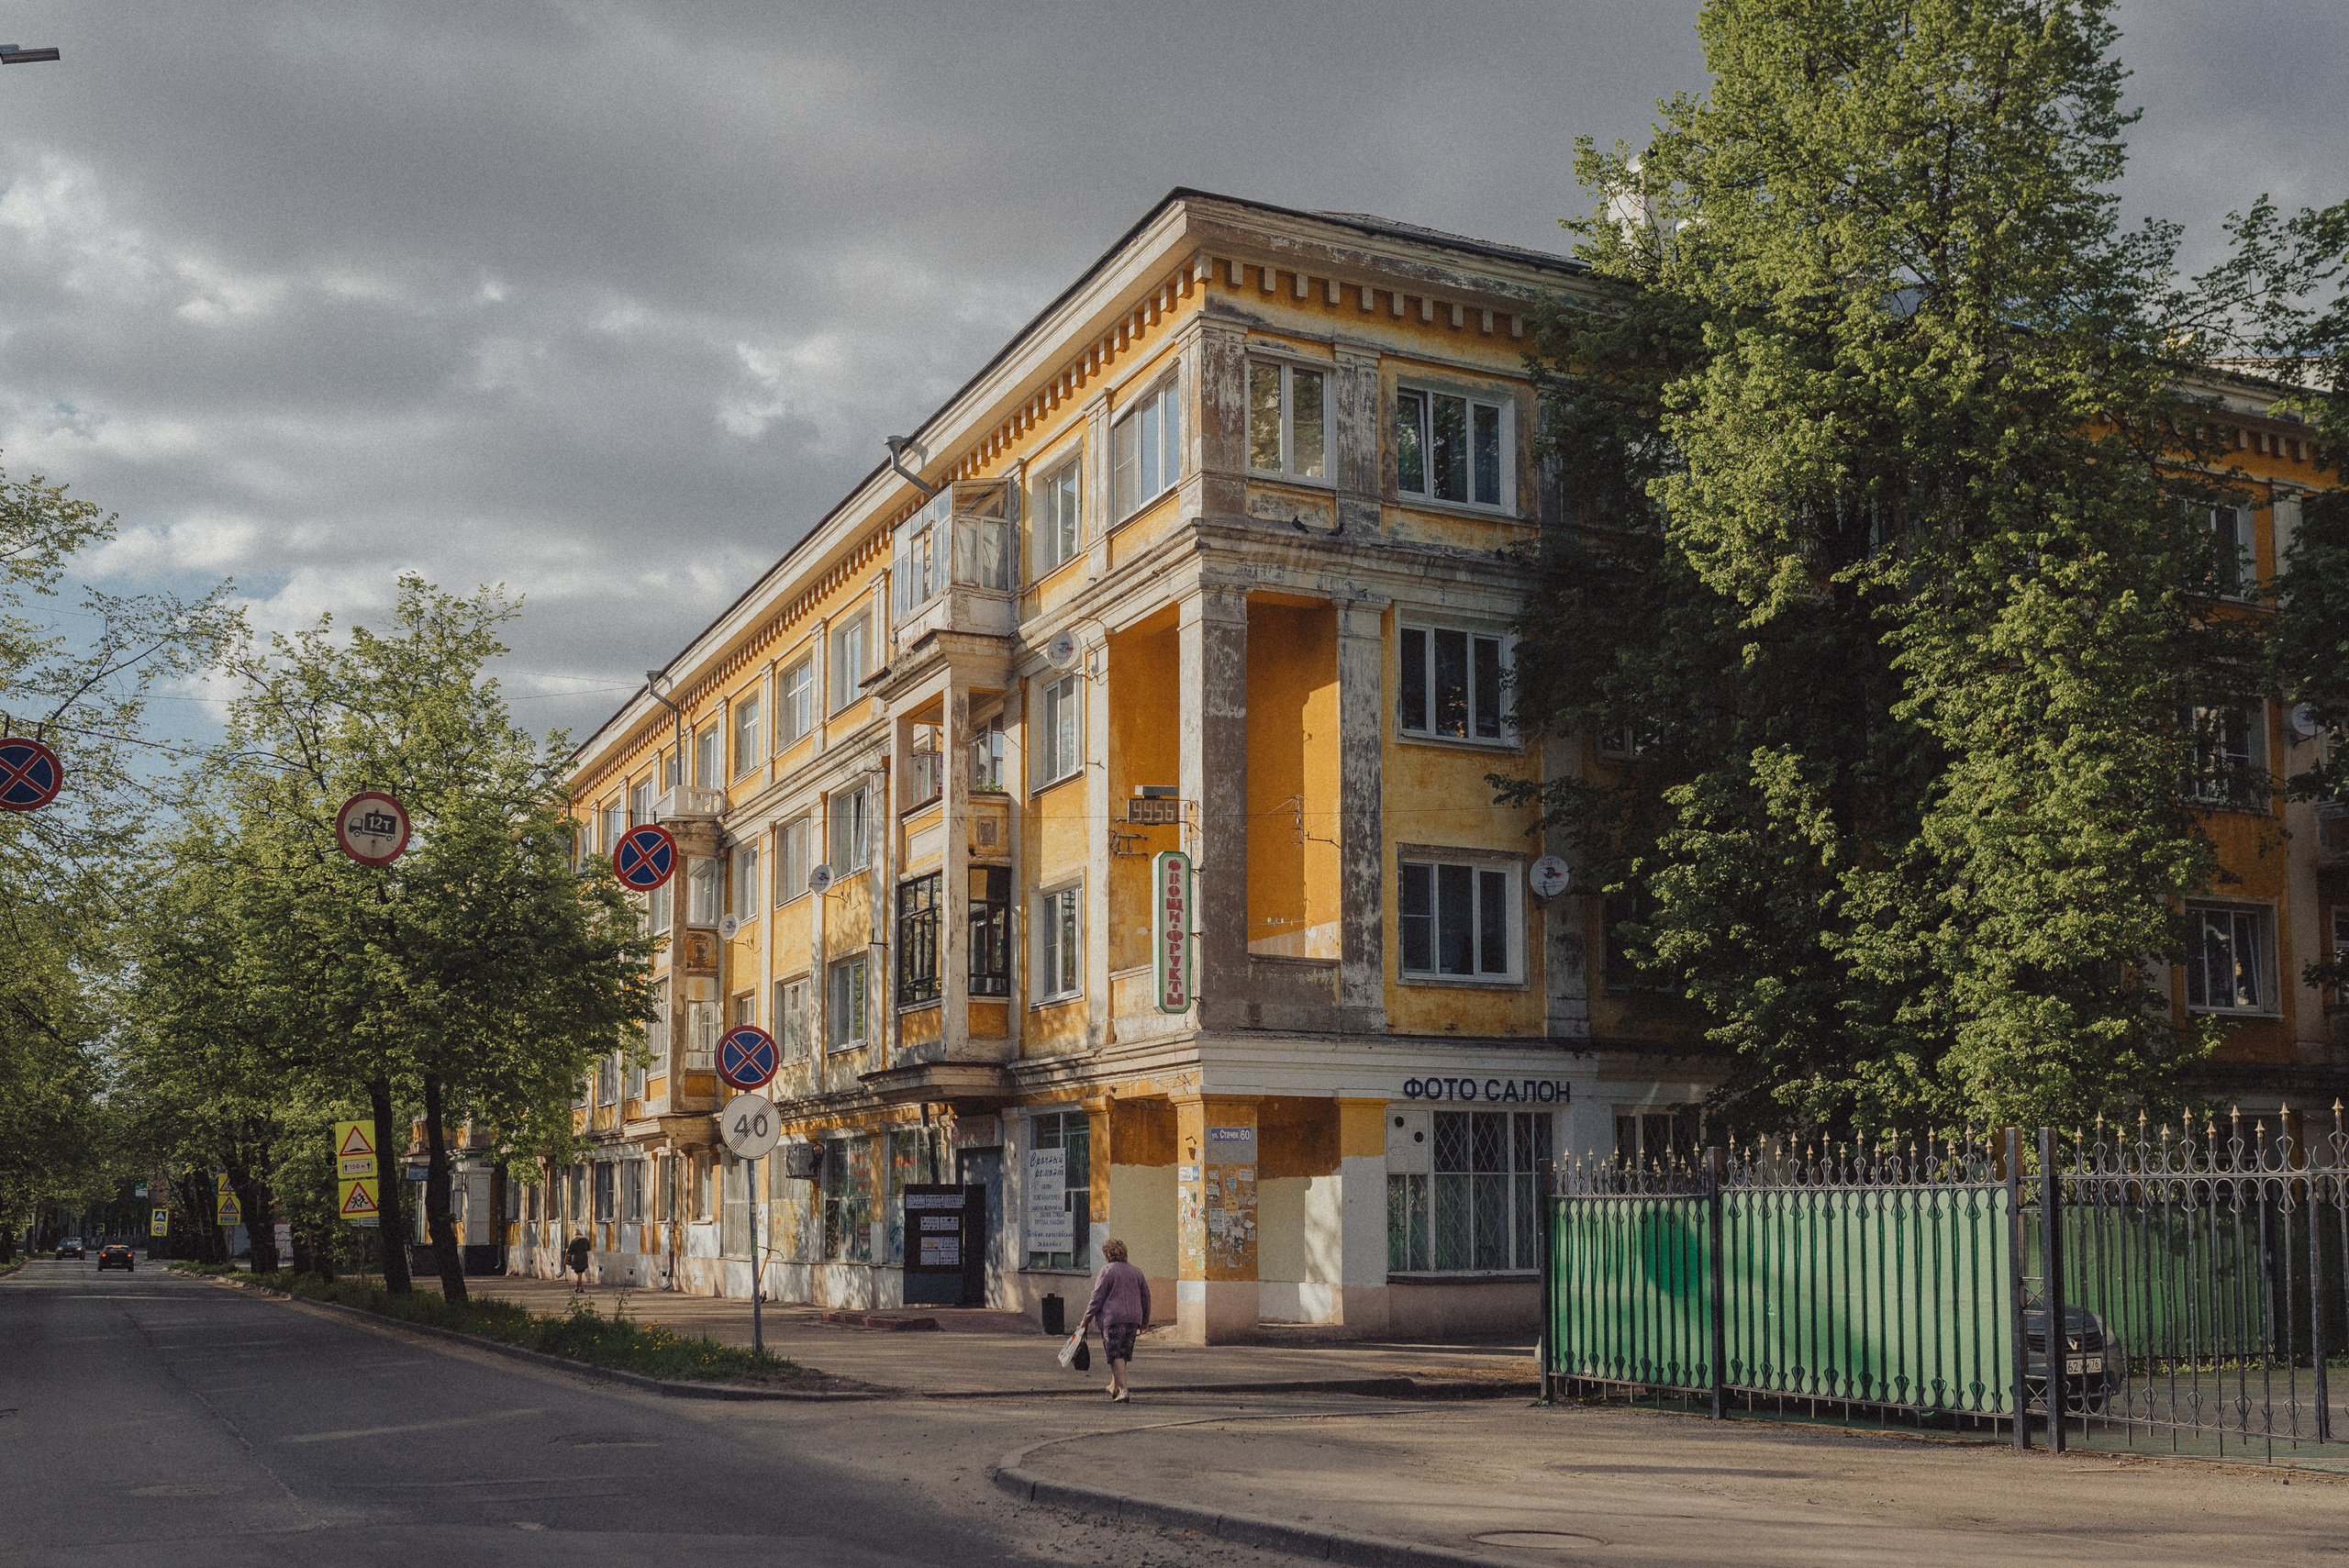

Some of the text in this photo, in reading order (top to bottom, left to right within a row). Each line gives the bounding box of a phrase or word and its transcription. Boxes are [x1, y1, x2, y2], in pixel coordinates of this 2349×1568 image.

[1403, 1077, 1571, 1103] ФОТО САЛОН
[733, 1114, 768, 1138] 40
[1219, 1129, 1239, 1140] Стачек
[1241, 1129, 1250, 1140] 60
[1030, 1152, 1063, 1168] Срочный
[1034, 1165, 1064, 1182] ремонт
